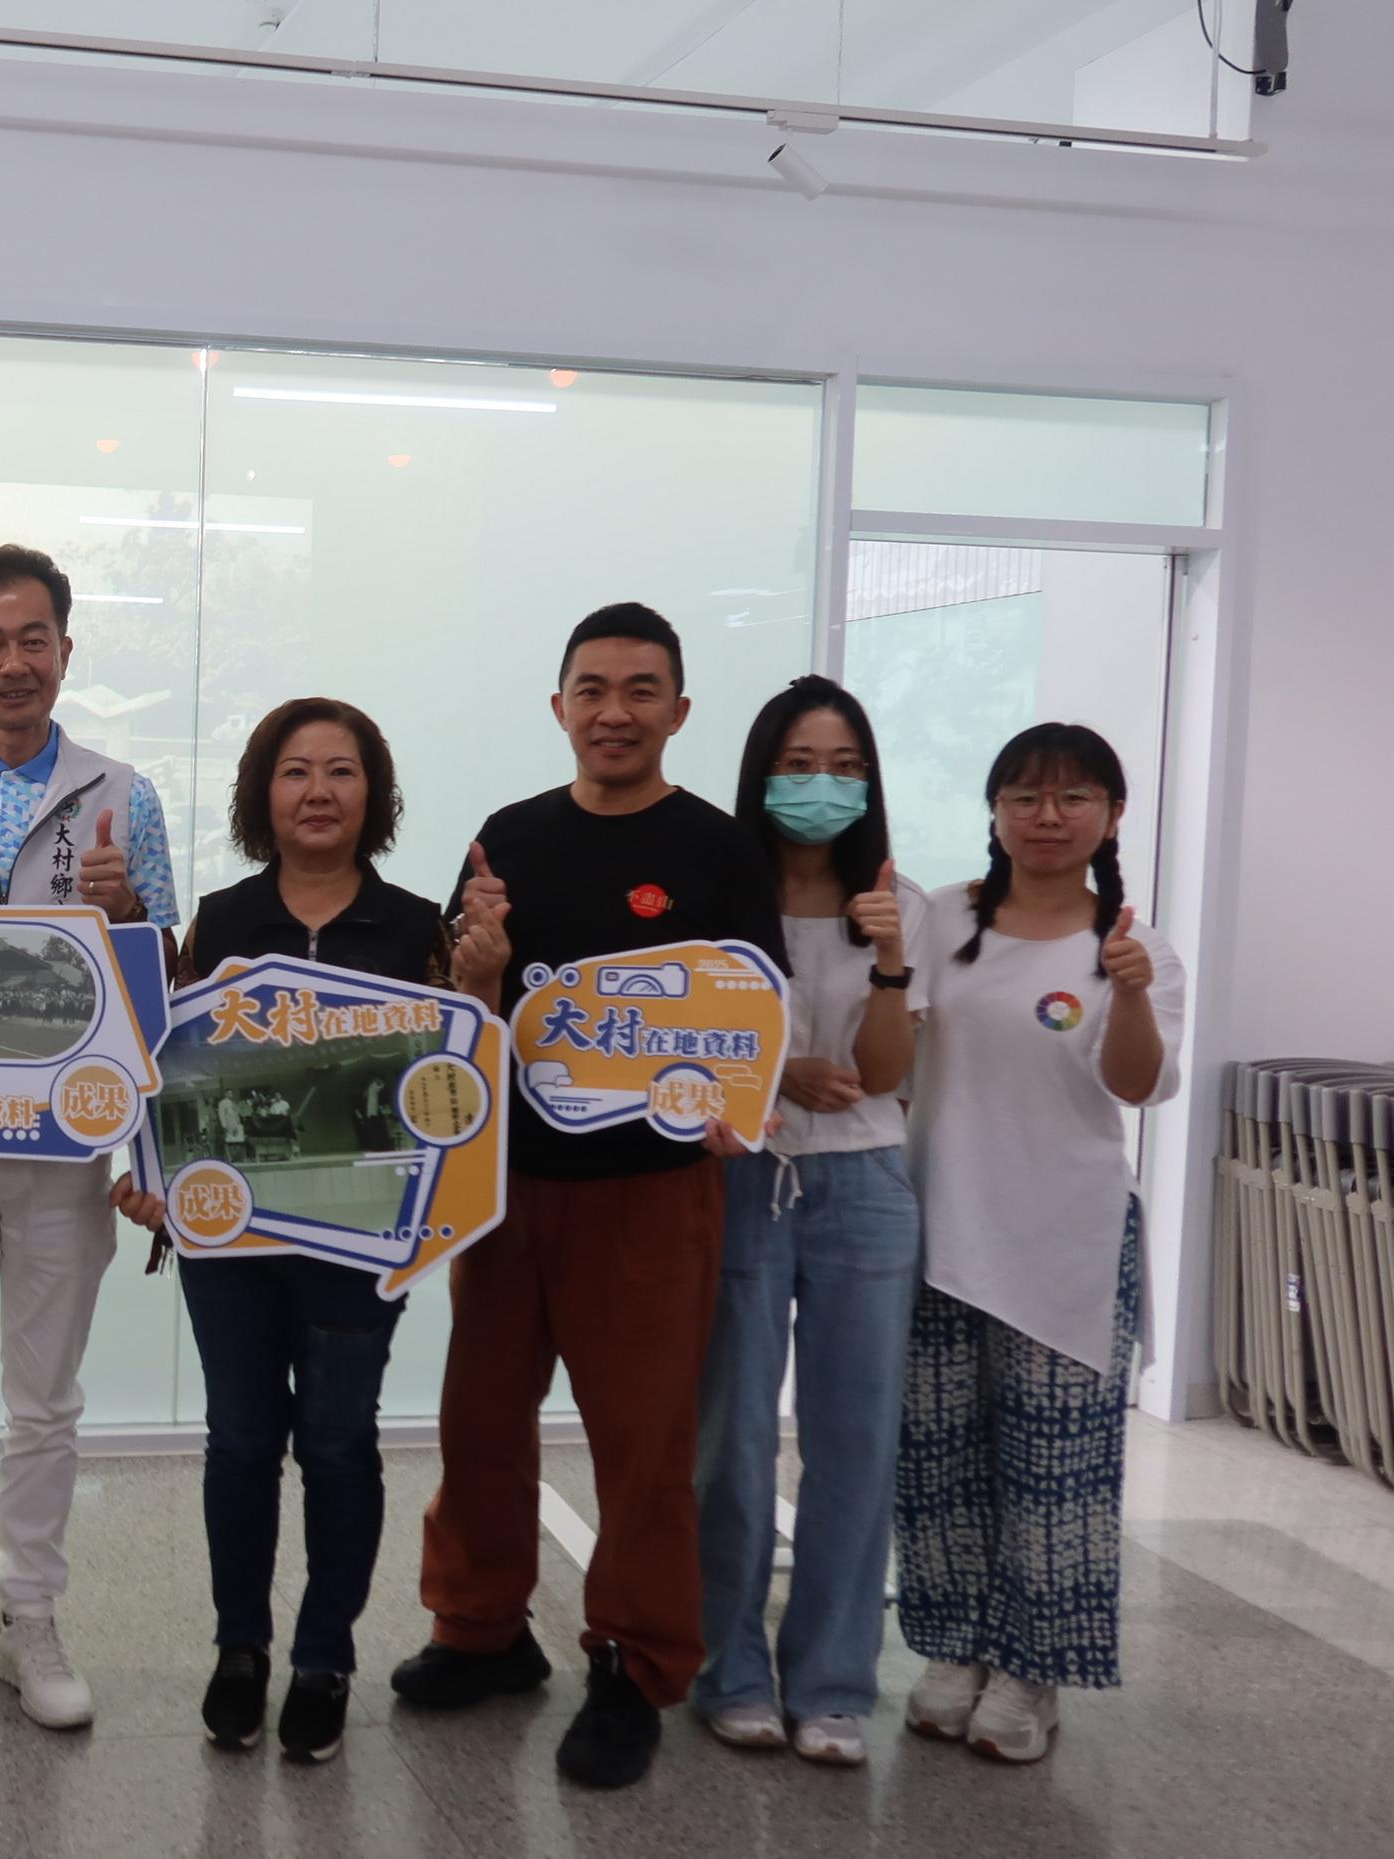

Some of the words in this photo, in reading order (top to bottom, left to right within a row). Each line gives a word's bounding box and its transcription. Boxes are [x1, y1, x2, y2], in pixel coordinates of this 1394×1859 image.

[50, 823, 75, 905] 大村鄉
[207, 987, 443, 1047] 大村在地資料
[536, 997, 760, 1061] 大村在地資料
[59, 1081, 129, 1123] 成果
[648, 1078, 727, 1119] 成果
[177, 1183, 244, 1223] 成果
